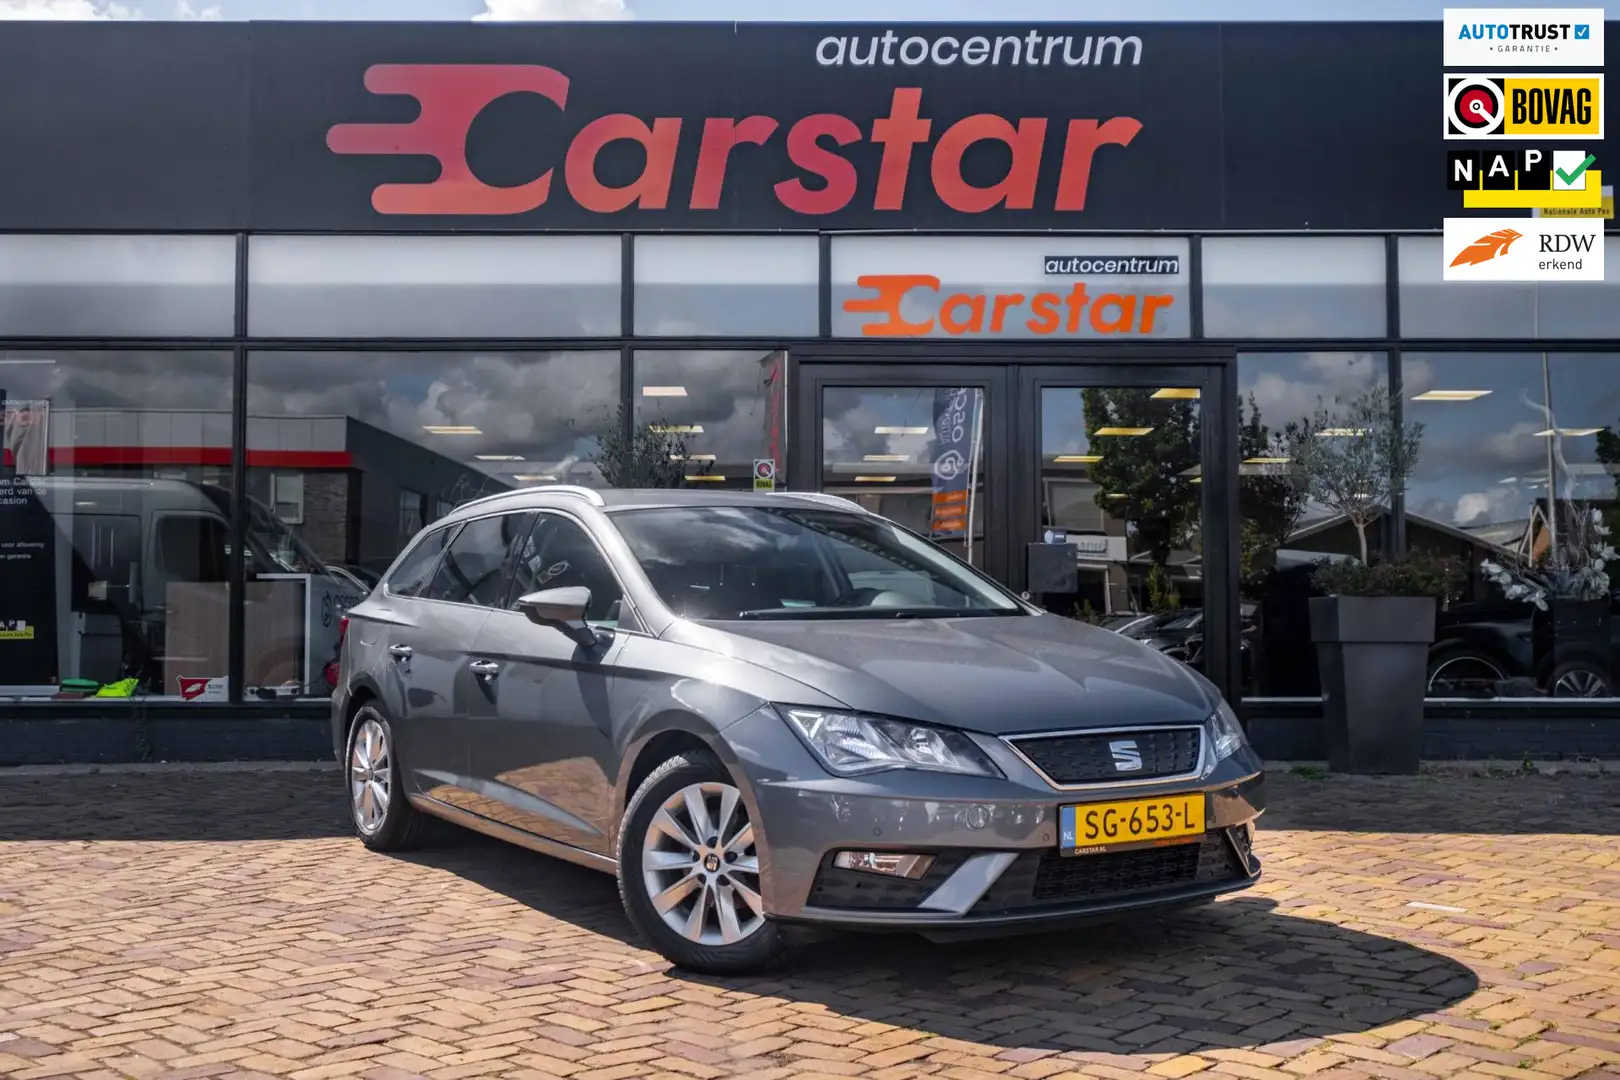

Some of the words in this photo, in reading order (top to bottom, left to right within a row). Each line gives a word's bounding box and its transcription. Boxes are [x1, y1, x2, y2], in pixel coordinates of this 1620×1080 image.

[815, 29, 1143, 67] autocentrum
[326, 63, 1144, 215] Carstar
[1045, 256, 1179, 274] autocentrum
[843, 274, 1175, 337] Carstar
[1063, 831, 1074, 841] NL
[1084, 801, 1196, 840] SG-653-L
[1074, 846, 1107, 855] CARSTAR.NL
